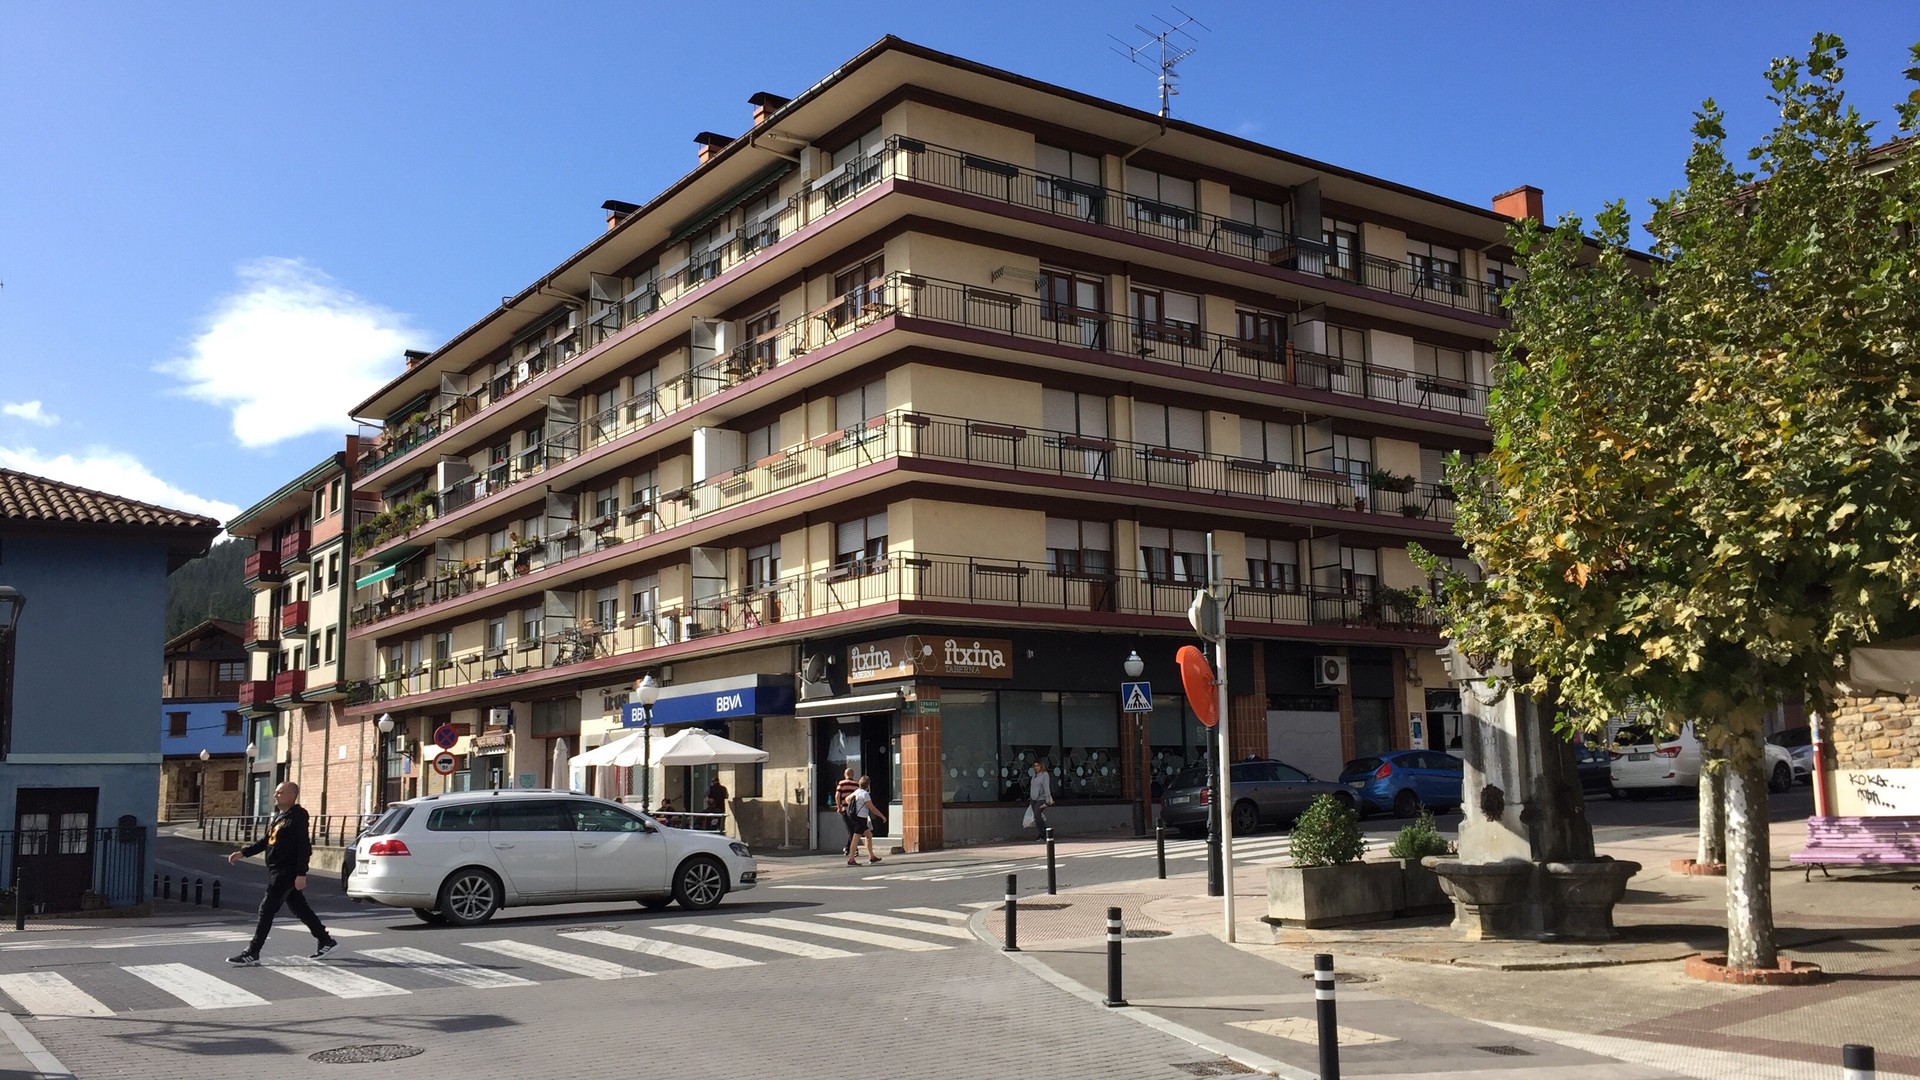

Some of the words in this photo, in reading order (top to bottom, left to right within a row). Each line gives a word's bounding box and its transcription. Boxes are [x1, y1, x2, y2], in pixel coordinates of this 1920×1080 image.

[851, 645, 892, 670] itxina
[945, 639, 1006, 670] itxina
[945, 665, 980, 674] TABERNA
[716, 693, 743, 712] BBVA
